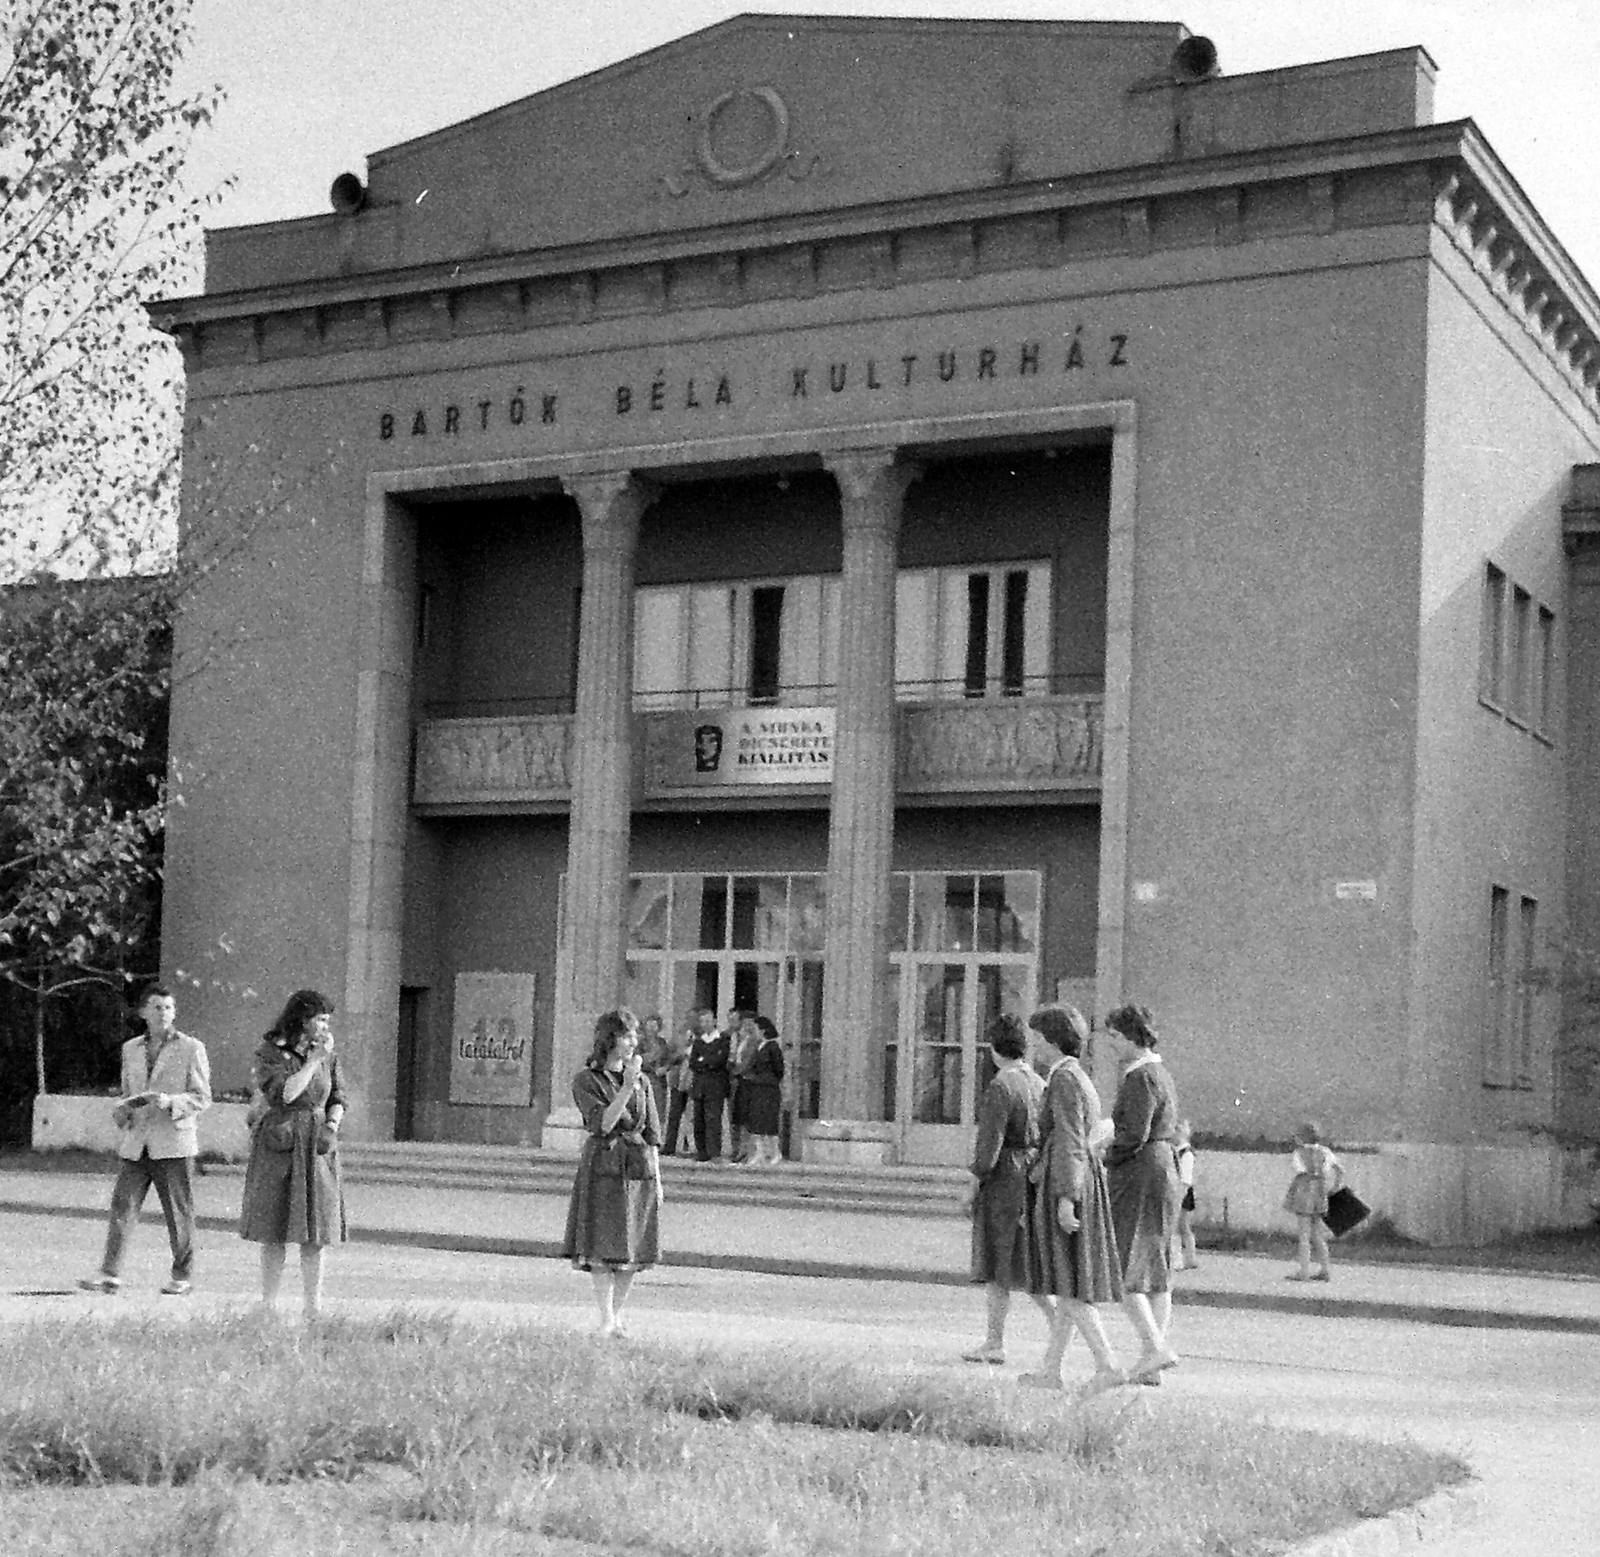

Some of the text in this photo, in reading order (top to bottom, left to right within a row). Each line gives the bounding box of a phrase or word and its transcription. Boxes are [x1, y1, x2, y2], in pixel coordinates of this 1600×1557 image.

[380, 324, 1128, 440] BARTÓK BÉLA KULTURHÁZ
